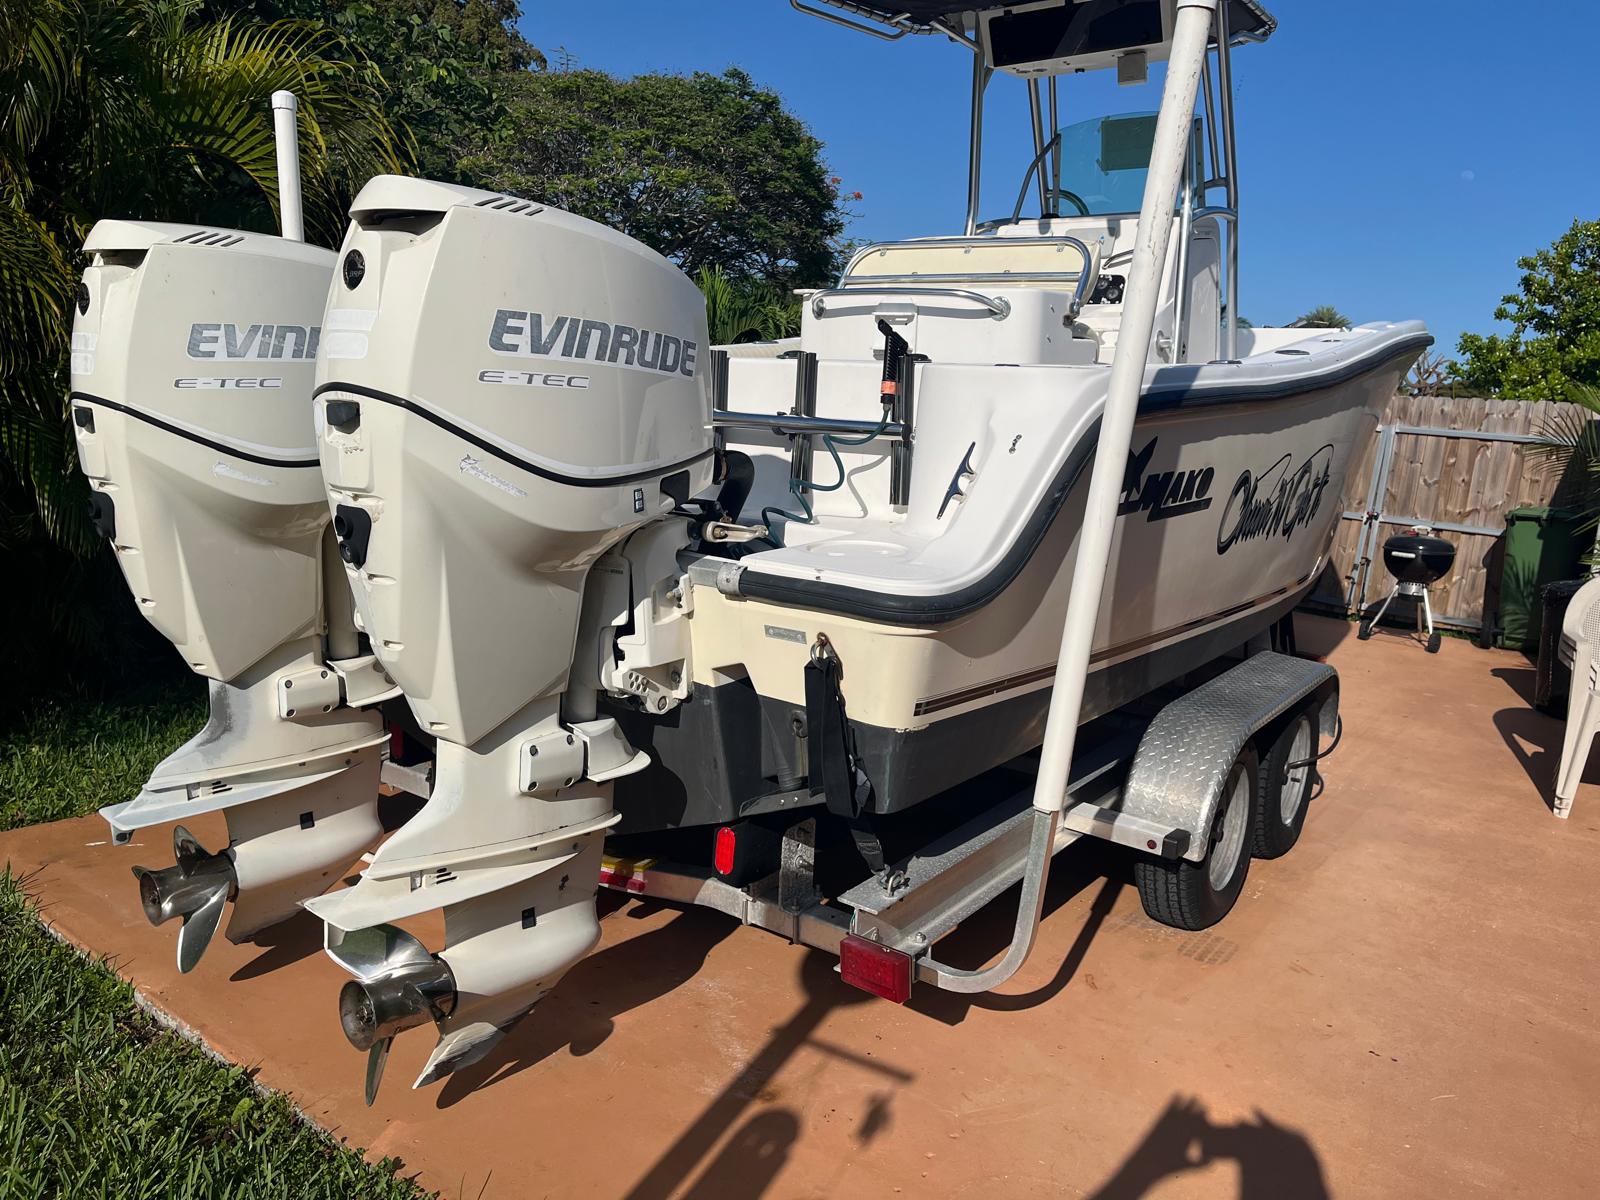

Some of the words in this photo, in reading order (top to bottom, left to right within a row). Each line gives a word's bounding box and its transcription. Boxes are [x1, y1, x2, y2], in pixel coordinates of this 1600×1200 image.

[489, 309, 697, 377] EVINRUDE
[174, 378, 282, 389] E-TEC
[478, 370, 590, 389] E-TEC
[1139, 467, 1215, 514] MAKO
